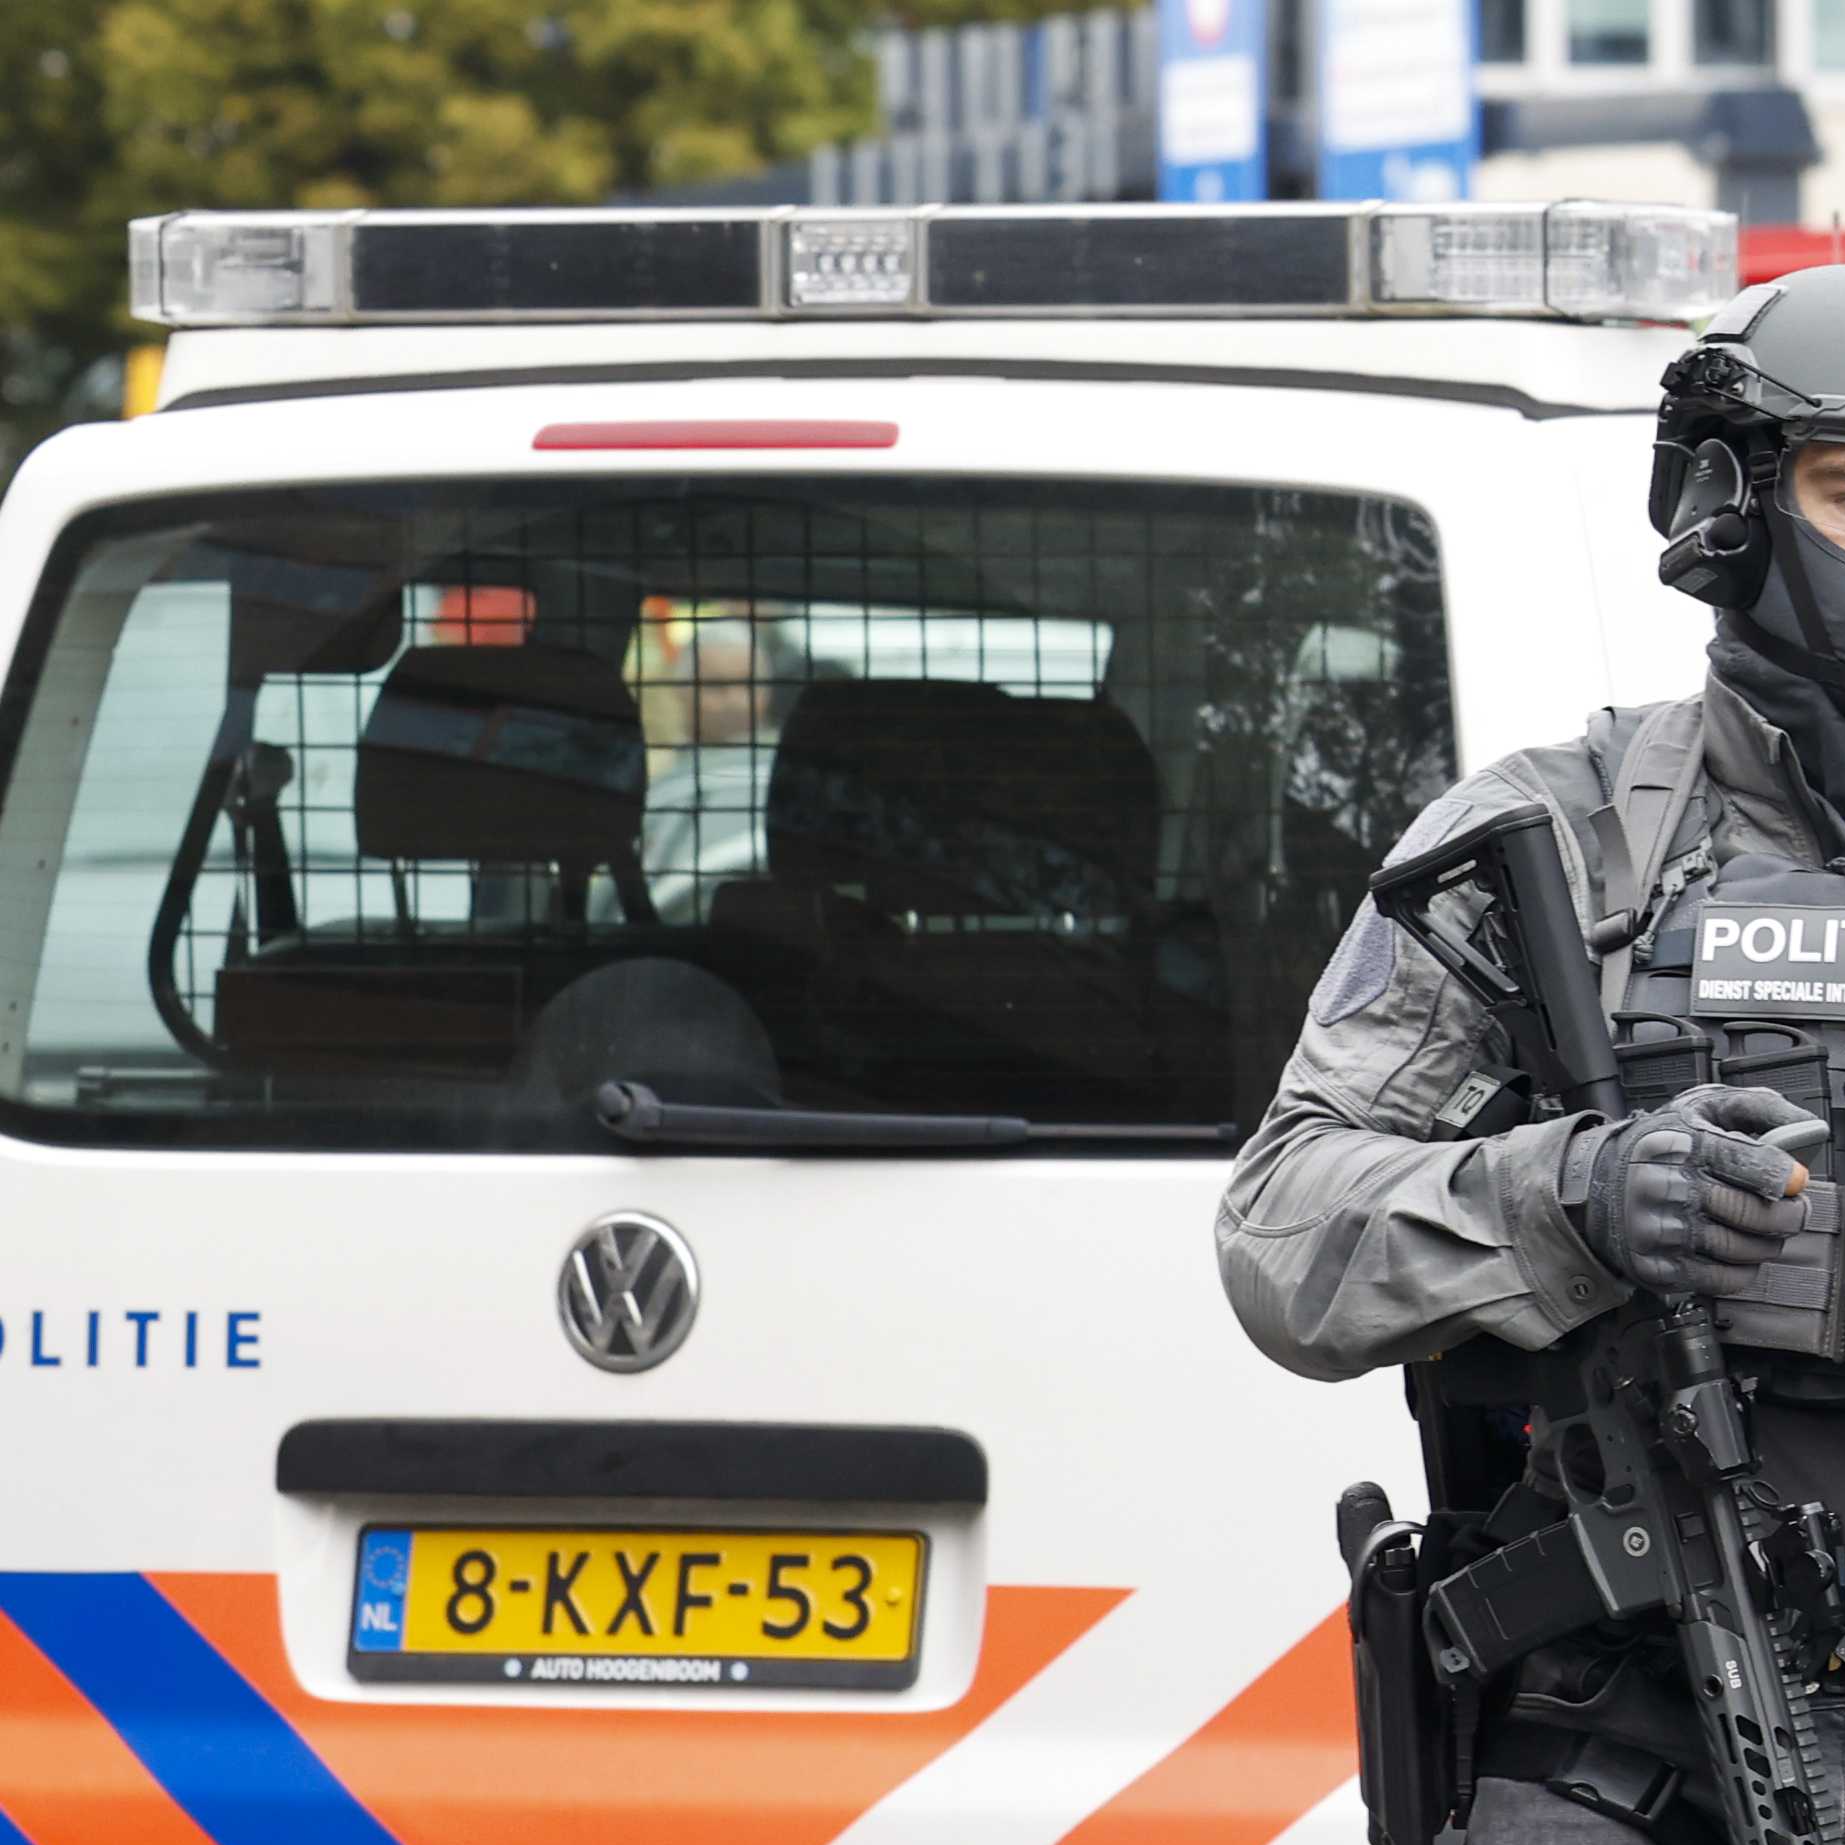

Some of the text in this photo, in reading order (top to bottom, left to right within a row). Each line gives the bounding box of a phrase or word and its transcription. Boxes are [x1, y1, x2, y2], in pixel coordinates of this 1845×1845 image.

[1699, 980, 1752, 1001] DIENST
[1753, 981, 1823, 1003] SPECIALE
[0, 1310, 262, 1369] LITIE
[445, 1548, 873, 1640] 8-KXF-53
[361, 1603, 398, 1632] NL
[531, 1656, 584, 1679] AUTO
[1725, 1660, 1742, 1689] SUB
